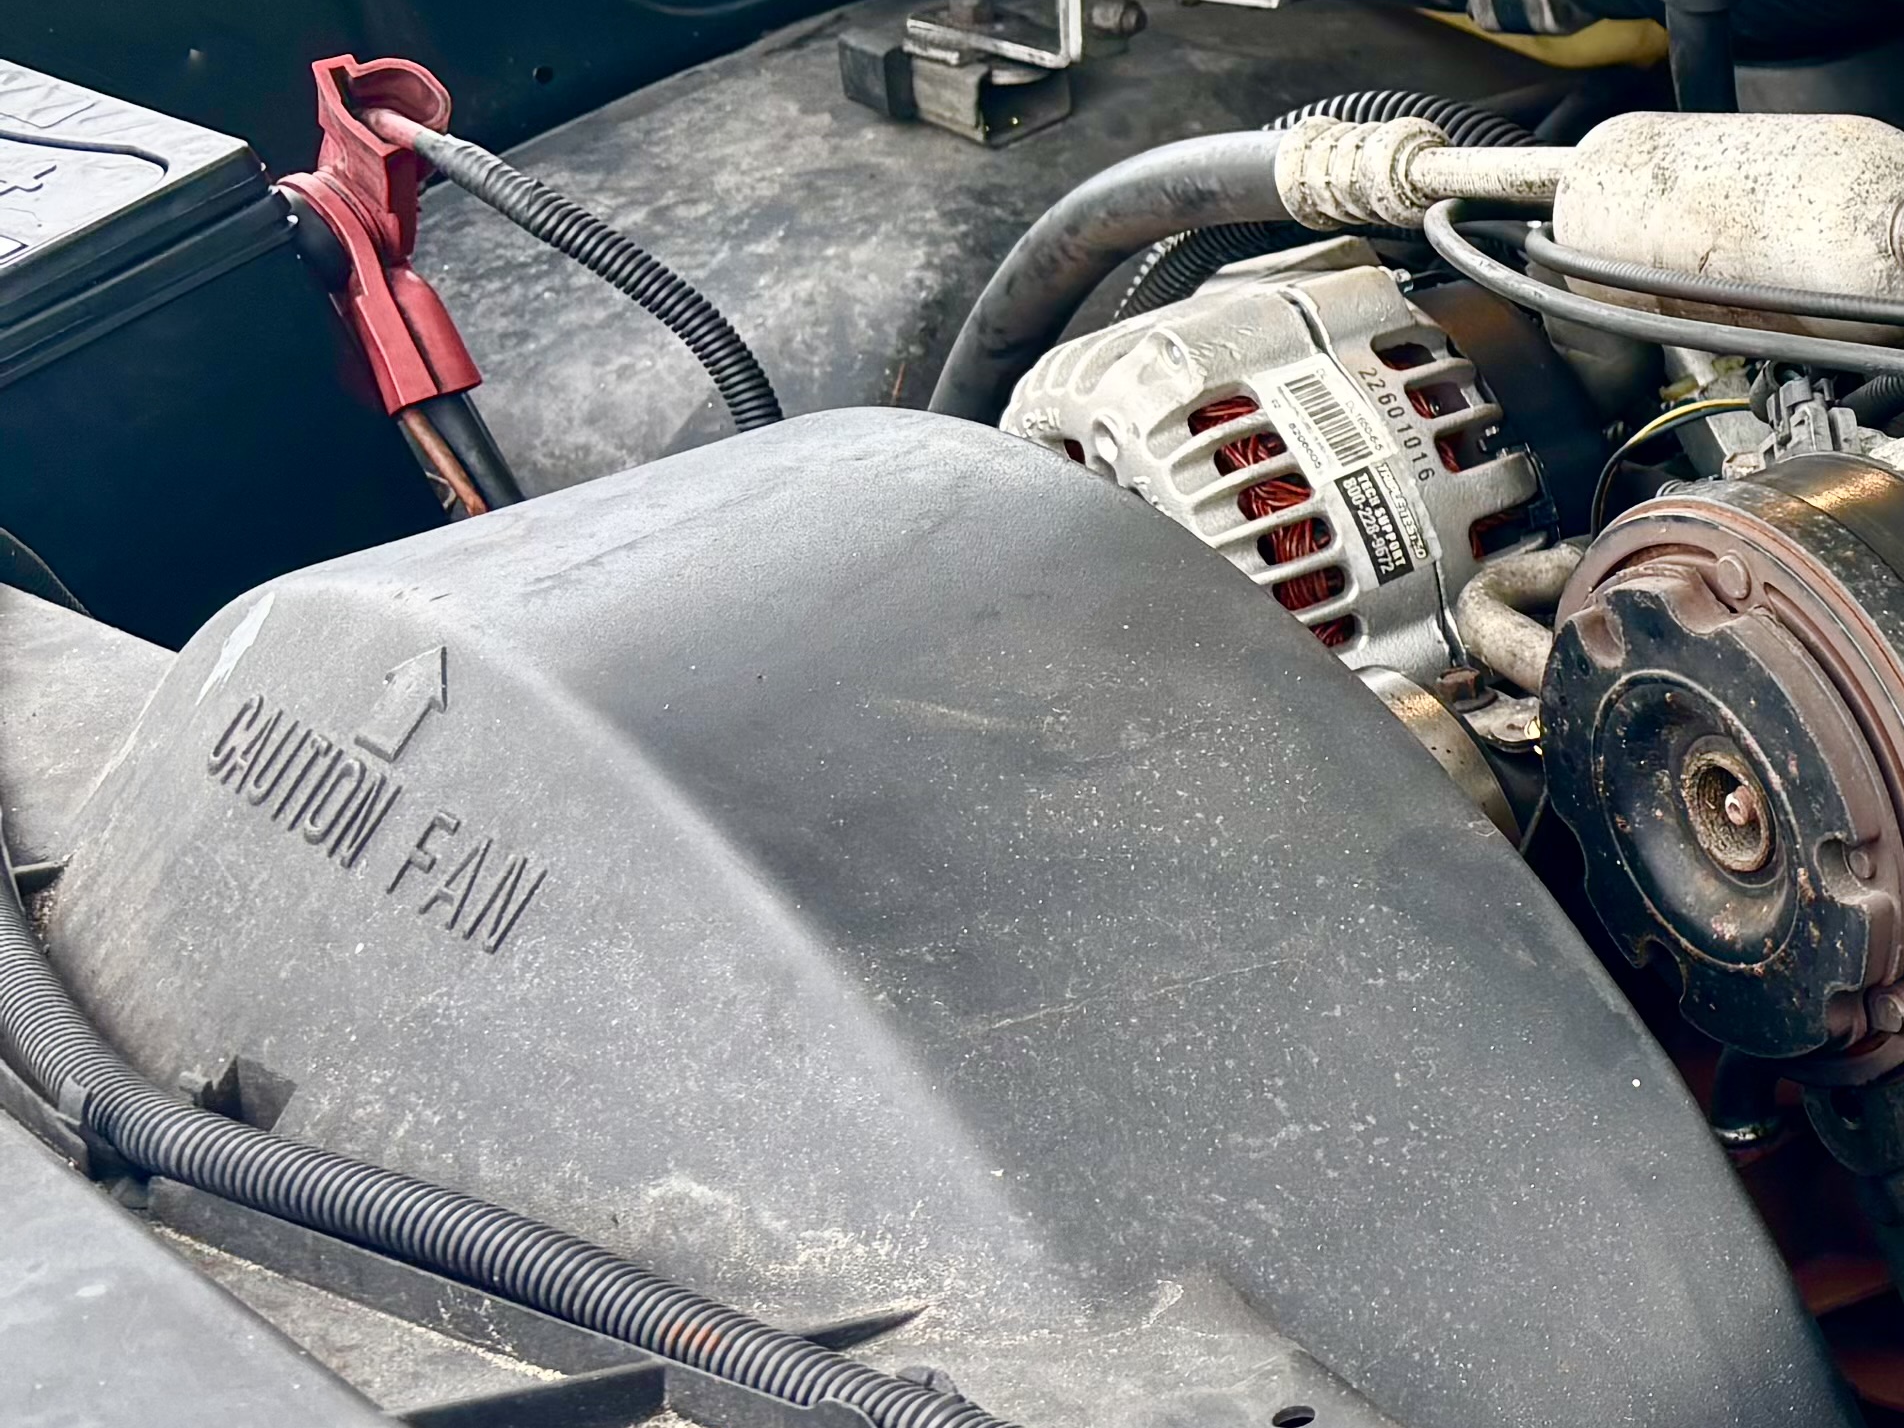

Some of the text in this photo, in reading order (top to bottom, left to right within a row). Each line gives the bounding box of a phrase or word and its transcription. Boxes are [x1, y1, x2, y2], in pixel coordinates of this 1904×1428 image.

[1358, 366, 1435, 481] 22601016
[1342, 476, 1395, 574] 800-228-9672
[1358, 472, 1407, 566] TECH SUPPORT
[207, 694, 549, 955] CAUTION FAN
